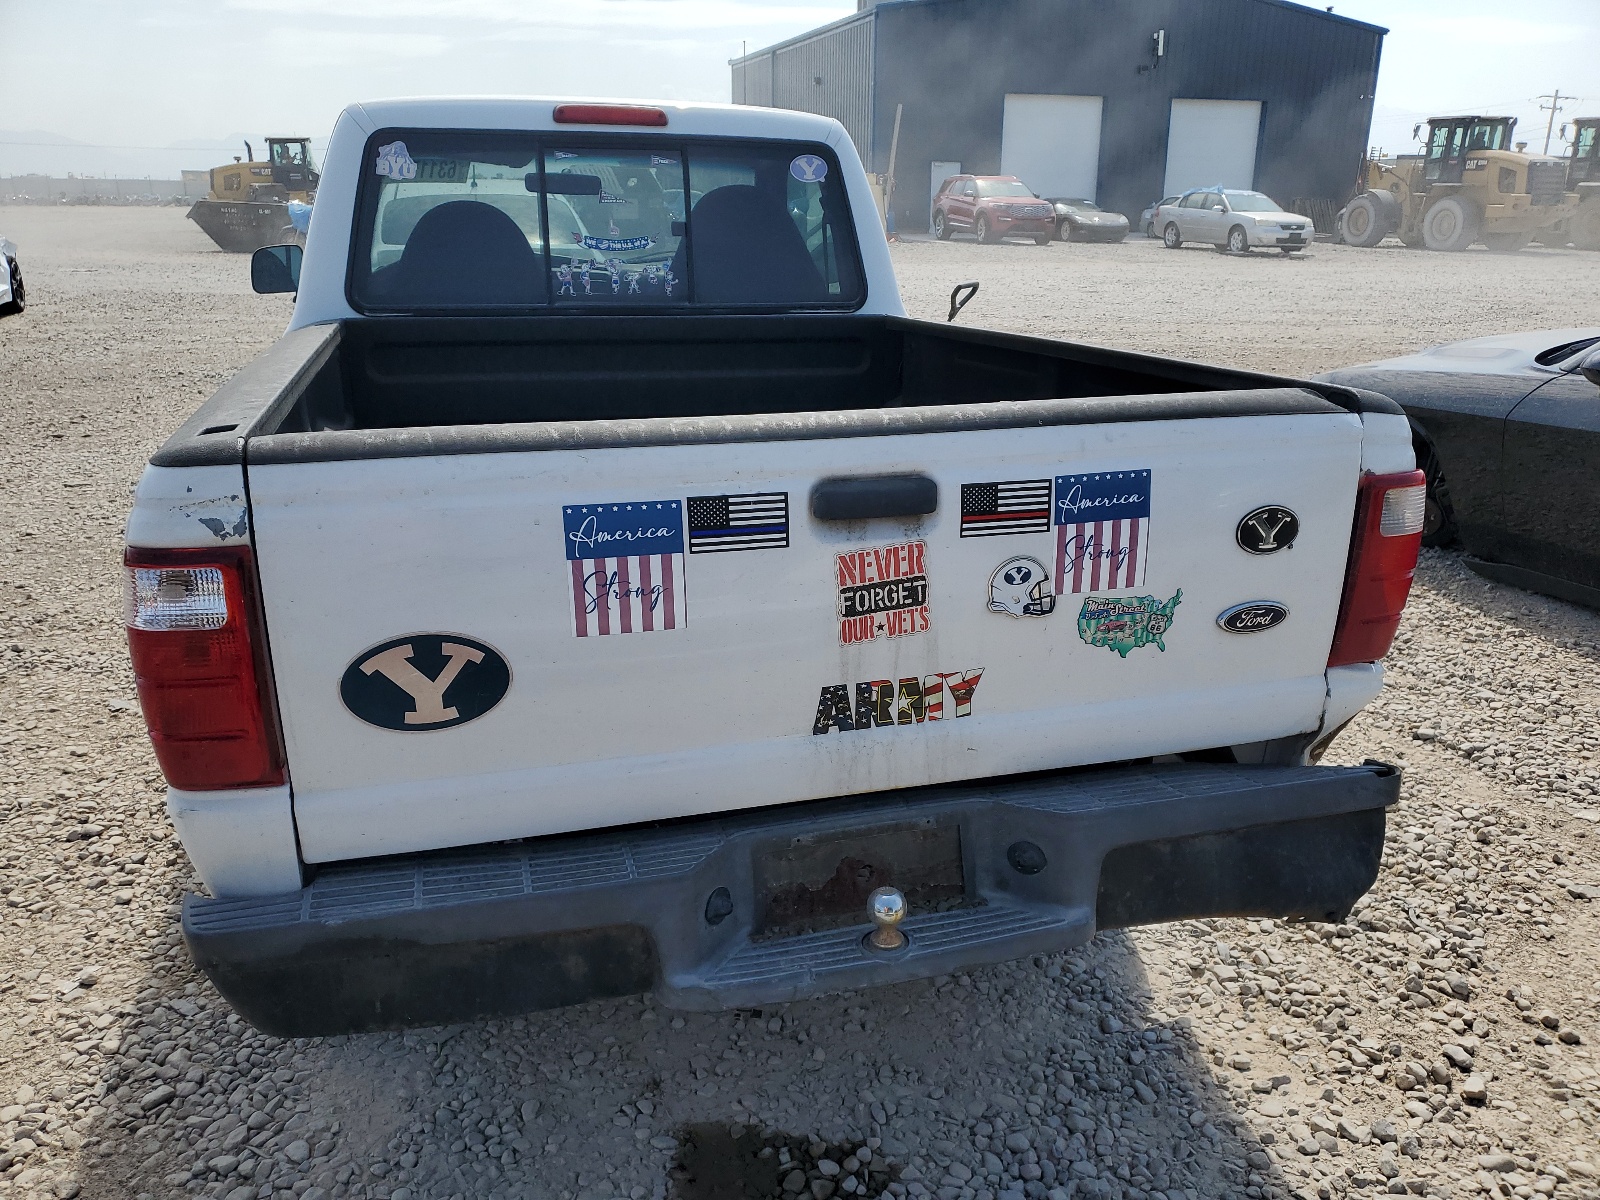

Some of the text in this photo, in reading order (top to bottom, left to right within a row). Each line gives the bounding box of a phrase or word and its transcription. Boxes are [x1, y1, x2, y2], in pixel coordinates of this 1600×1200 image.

[376, 156, 417, 180] BYU
[795, 157, 821, 180] Y
[1465, 159, 1478, 170] CAT
[1058, 484, 1145, 523] America
[569, 515, 675, 558] America
[1247, 511, 1292, 549] Y
[837, 542, 925, 586] NEVER
[1064, 534, 1134, 574] Strong
[583, 570, 669, 614] Strong
[1008, 567, 1029, 585] Y
[840, 580, 927, 615] FORGET
[1087, 599, 1145, 616] Main Street
[840, 605, 930, 644] OUR VETS
[1150, 624, 1162, 632] 66
[1236, 609, 1274, 627] Ford
[358, 641, 486, 724] Y
[812, 667, 986, 735] ARMY
